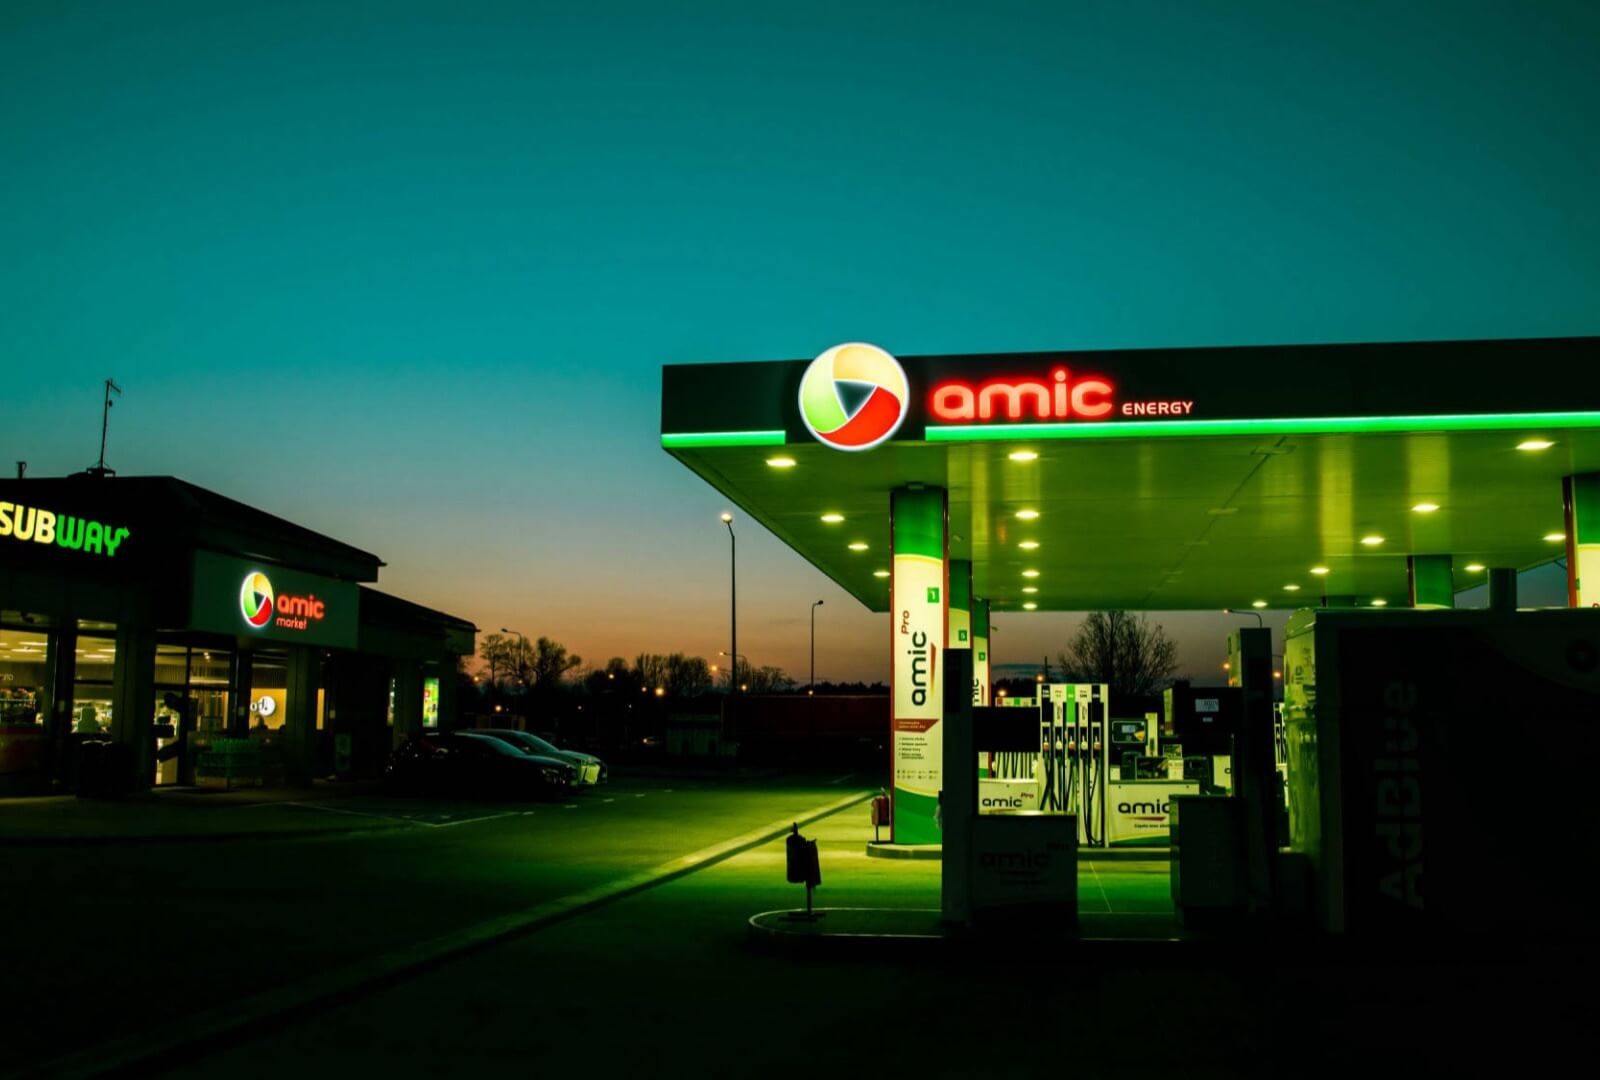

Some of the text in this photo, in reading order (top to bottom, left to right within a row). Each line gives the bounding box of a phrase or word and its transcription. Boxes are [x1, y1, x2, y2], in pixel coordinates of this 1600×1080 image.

[933, 370, 1193, 419] amic ENERGY
[0, 501, 130, 558] SUBWAY
[277, 594, 324, 619] amic
[276, 616, 307, 630] market
[901, 610, 910, 634] Pro
[907, 631, 926, 706] amic
[982, 796, 1023, 807] amic
[1118, 798, 1170, 814] amic
[1376, 679, 1424, 910] AdBlue
[979, 847, 1049, 867] amic
